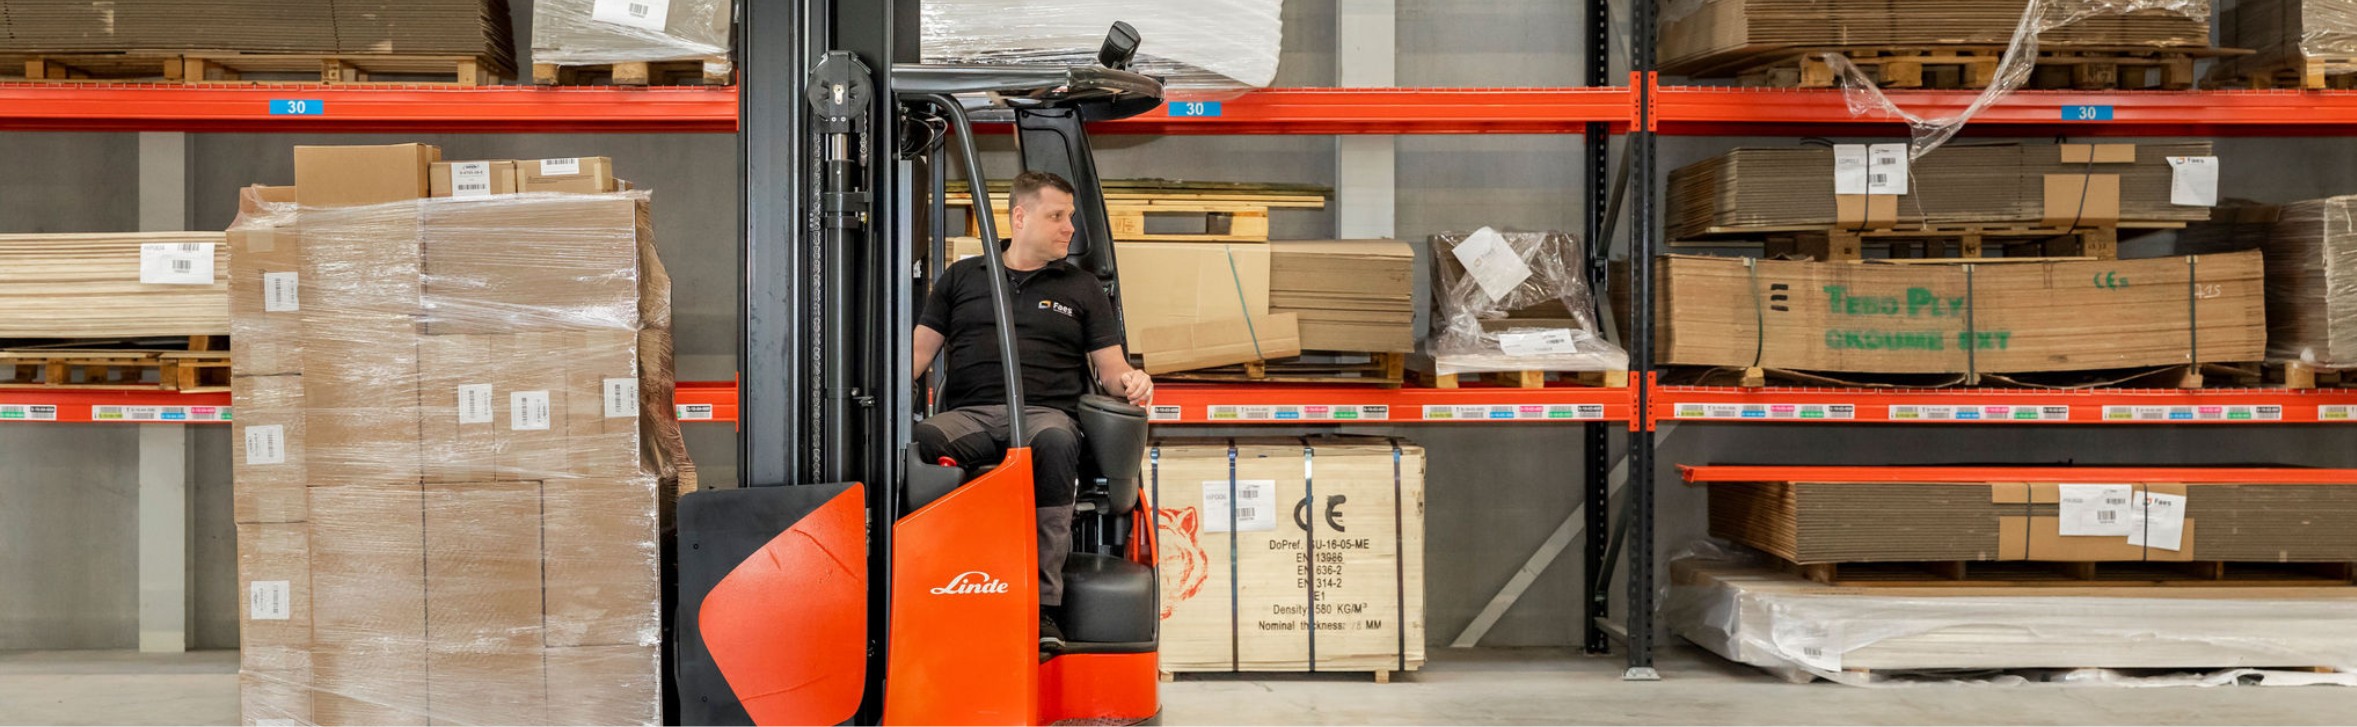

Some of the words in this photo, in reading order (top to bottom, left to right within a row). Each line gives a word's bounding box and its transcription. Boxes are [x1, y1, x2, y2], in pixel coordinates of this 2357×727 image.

[287, 100, 307, 114] 30
[1185, 102, 1205, 116] 30
[2078, 106, 2097, 120] 30
[2154, 498, 2172, 507] Faes
[1269, 538, 1303, 550] DoPref.
[1316, 565, 1342, 576] 636-2
[930, 570, 1009, 595] Linde
[1316, 578, 1342, 589] 314-2
[1314, 591, 1326, 601] E1
[1315, 603, 1331, 614] 580
[1258, 620, 1295, 631] Nominal
[1366, 620, 1382, 631] MM
